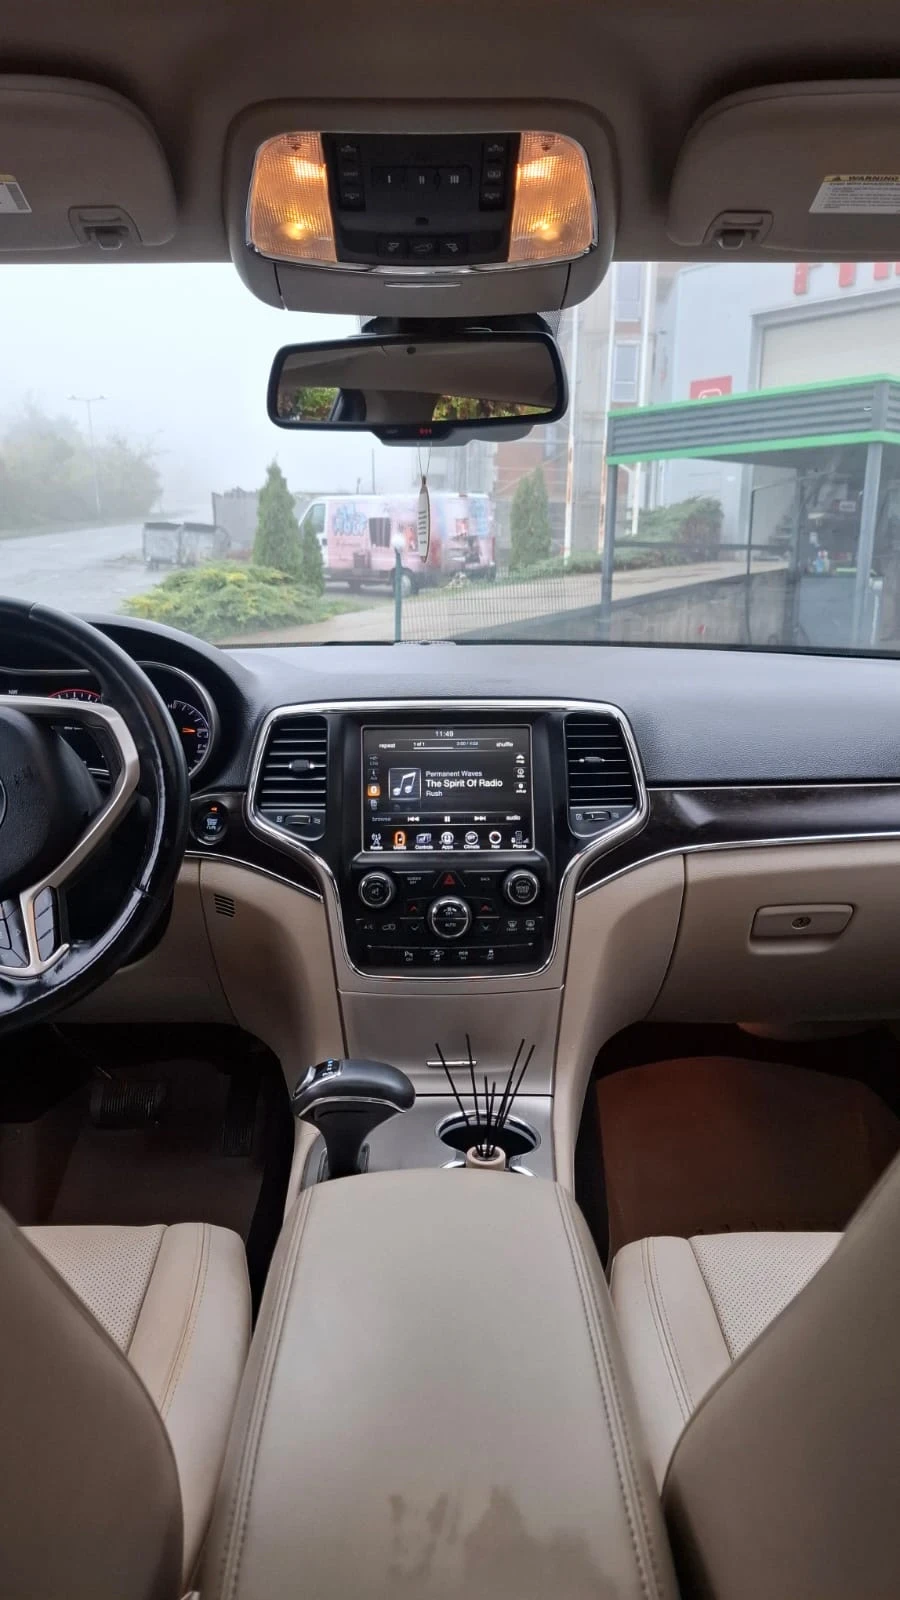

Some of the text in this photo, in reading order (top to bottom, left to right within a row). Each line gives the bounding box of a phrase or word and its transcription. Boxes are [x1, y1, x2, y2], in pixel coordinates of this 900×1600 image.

[426, 779, 503, 789] The Spirit Of Radio
